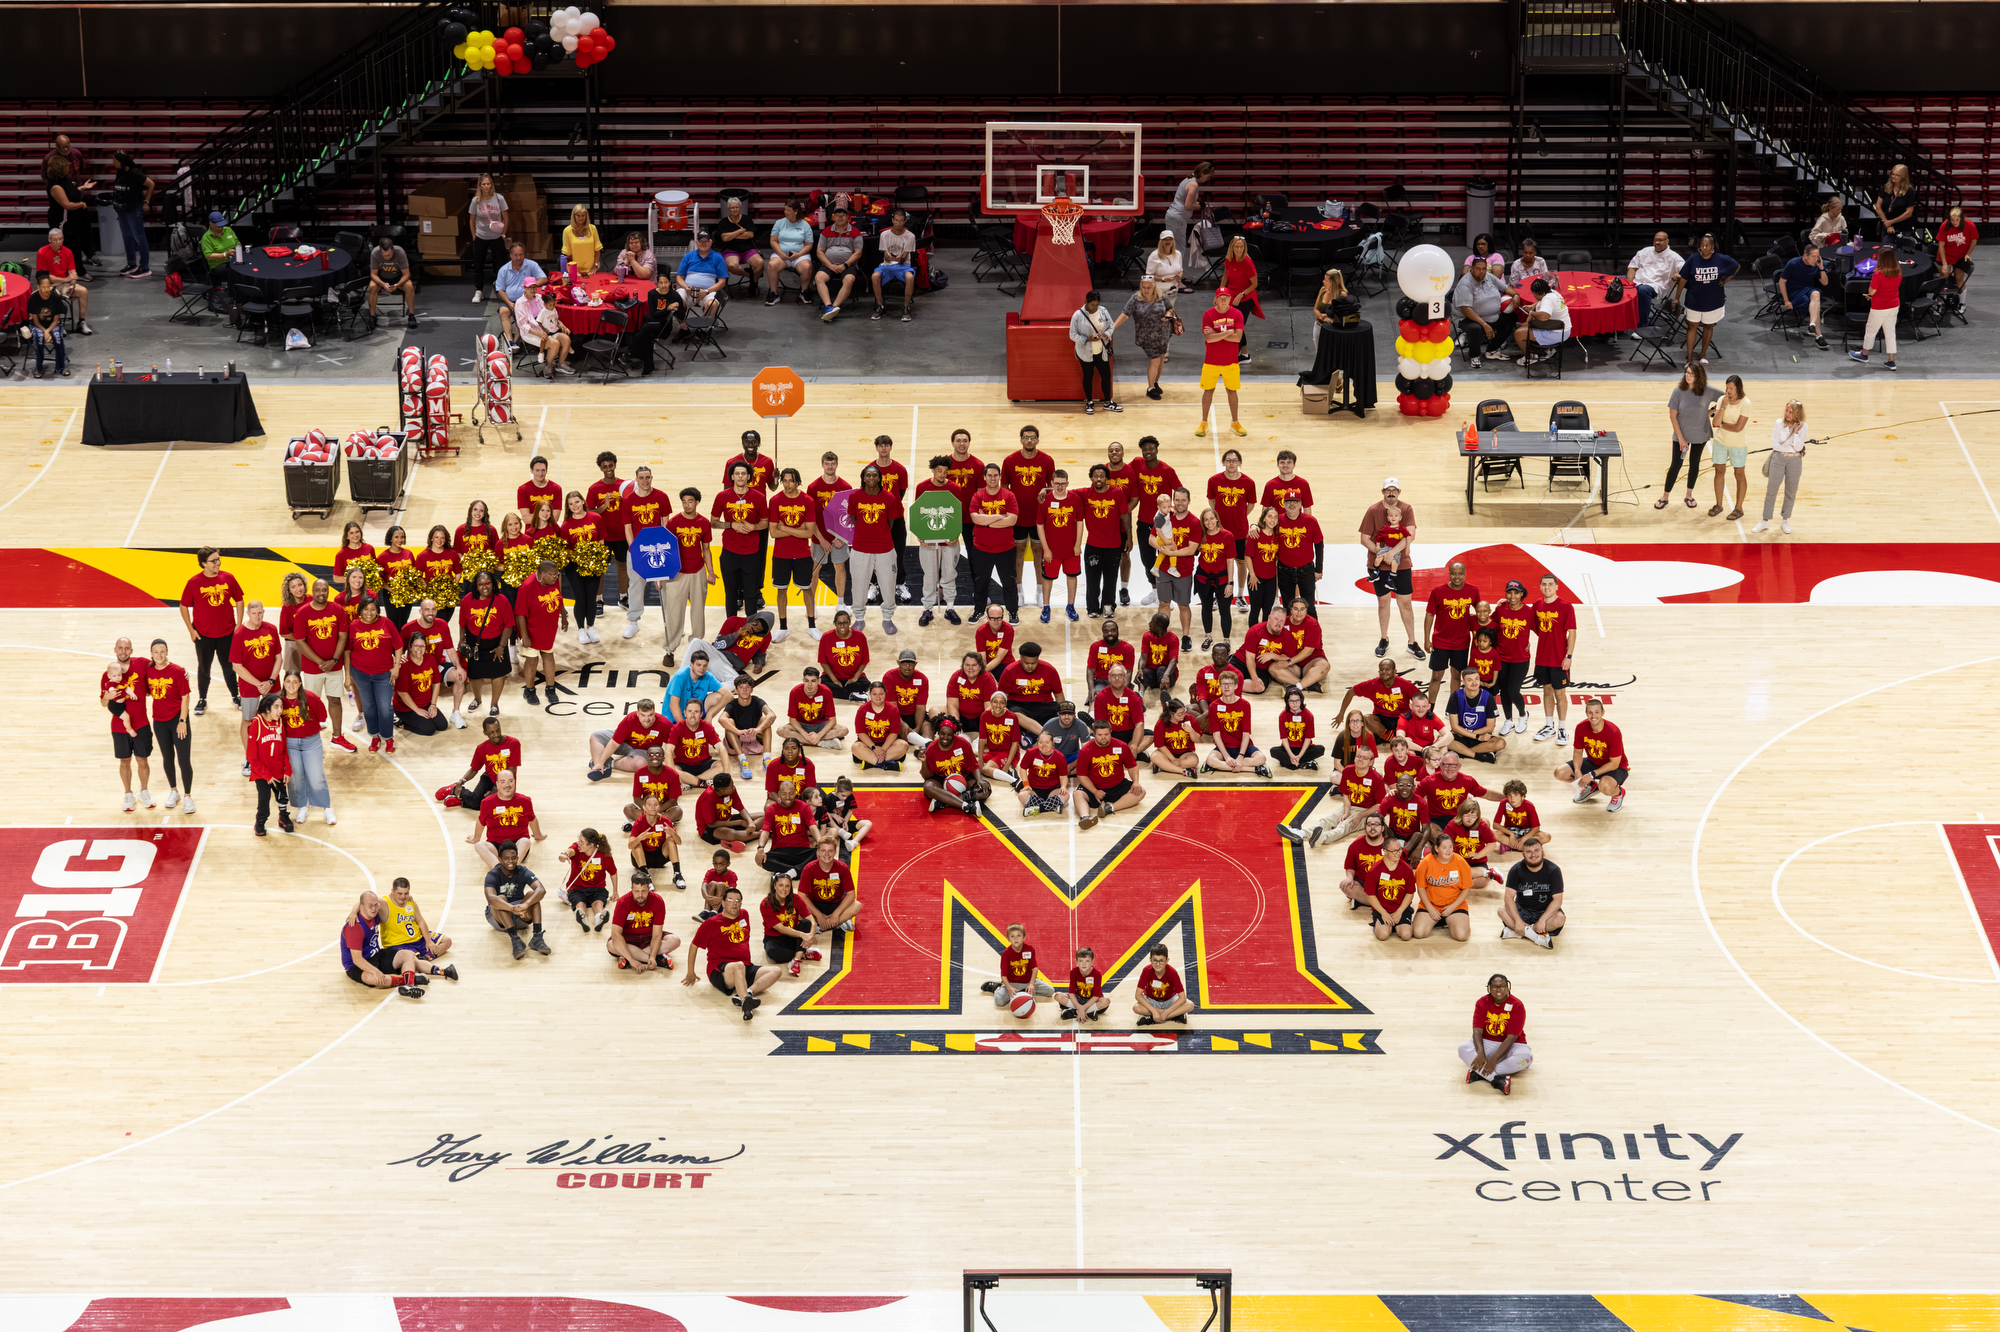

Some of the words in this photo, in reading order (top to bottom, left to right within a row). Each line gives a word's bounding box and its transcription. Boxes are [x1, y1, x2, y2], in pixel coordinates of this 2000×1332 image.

[1695, 266, 1719, 275] WICKED
[1432, 302, 1440, 313] 3
[429, 399, 444, 413] M
[270, 742, 275, 757] 1
[405, 923, 415, 938] 6
[1432, 1120, 1745, 1171] xfinity
[386, 1133, 513, 1183] Gary
[525, 1134, 746, 1166] Williams
[555, 1172, 713, 1189] COURT
[1475, 1172, 1723, 1202] center
